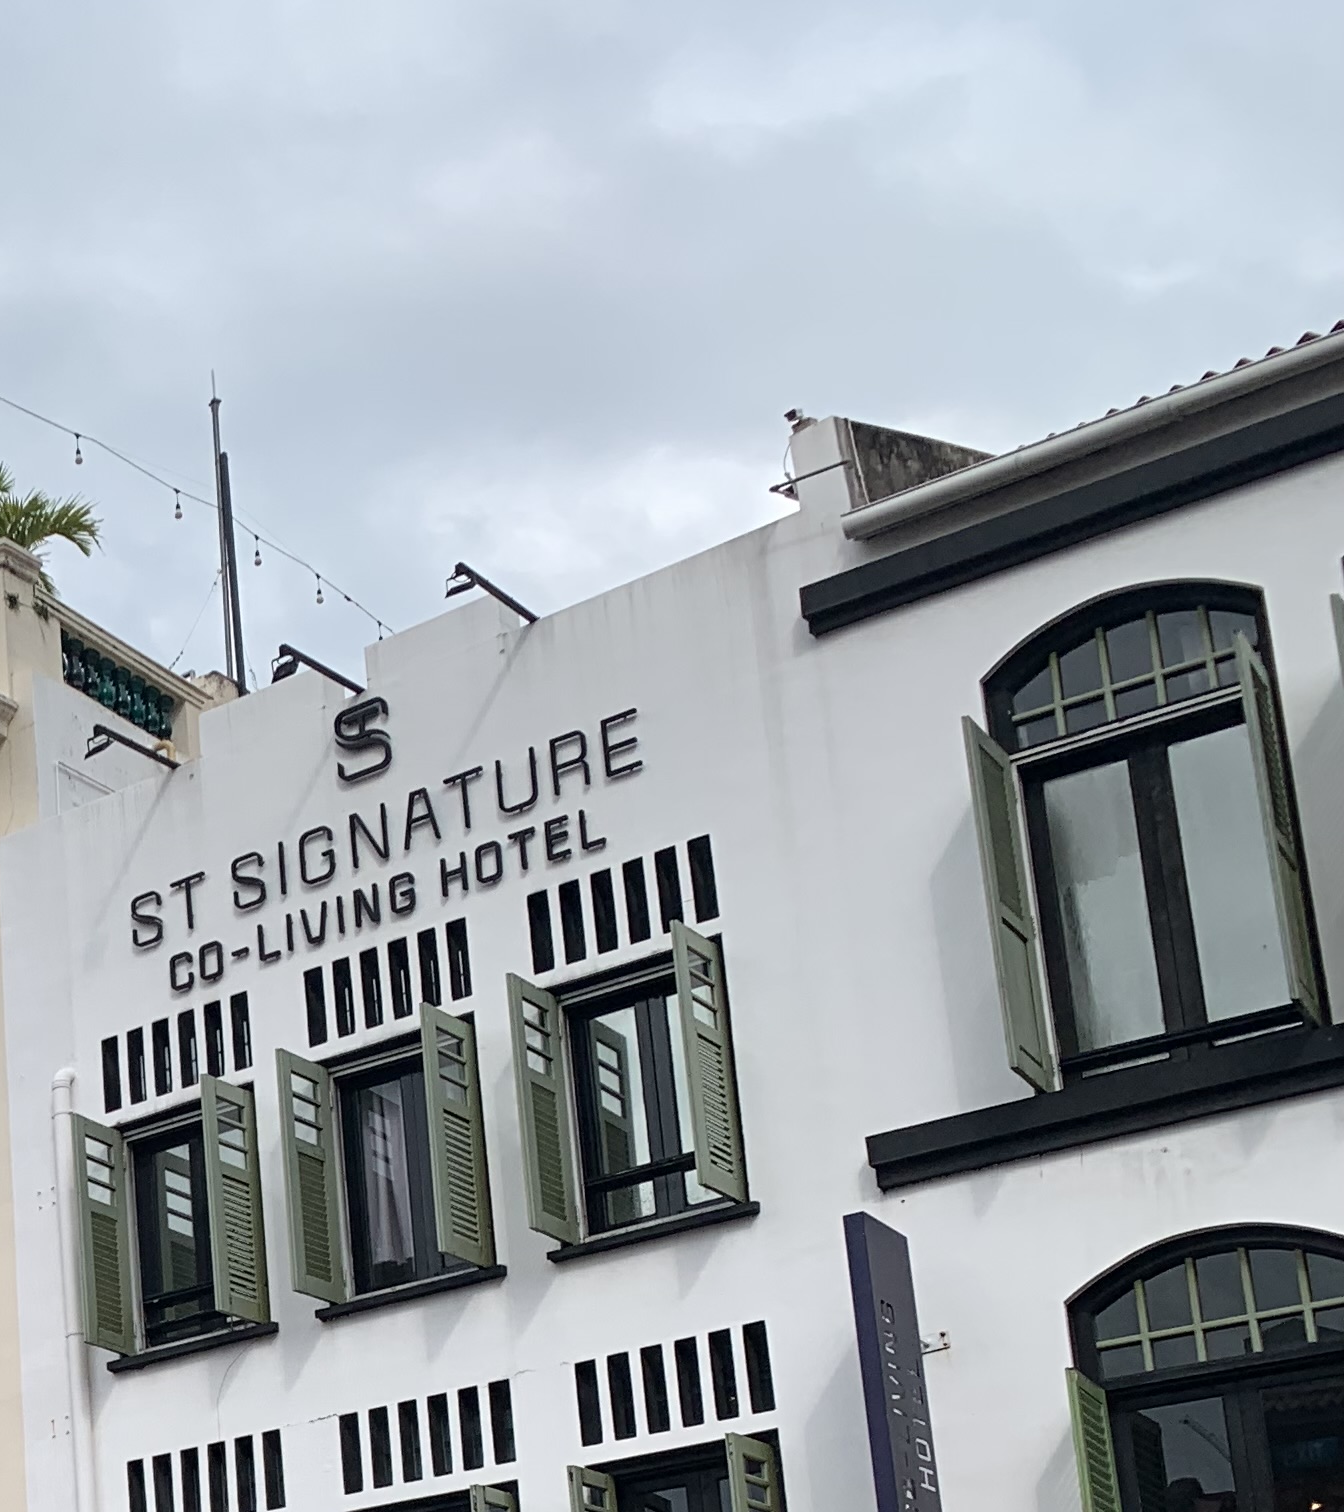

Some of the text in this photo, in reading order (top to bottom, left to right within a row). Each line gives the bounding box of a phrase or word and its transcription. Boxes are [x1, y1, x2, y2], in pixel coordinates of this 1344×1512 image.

[130, 706, 645, 950] ST SIGNATURE
[169, 808, 607, 993] CO-LIVING HOTEL
